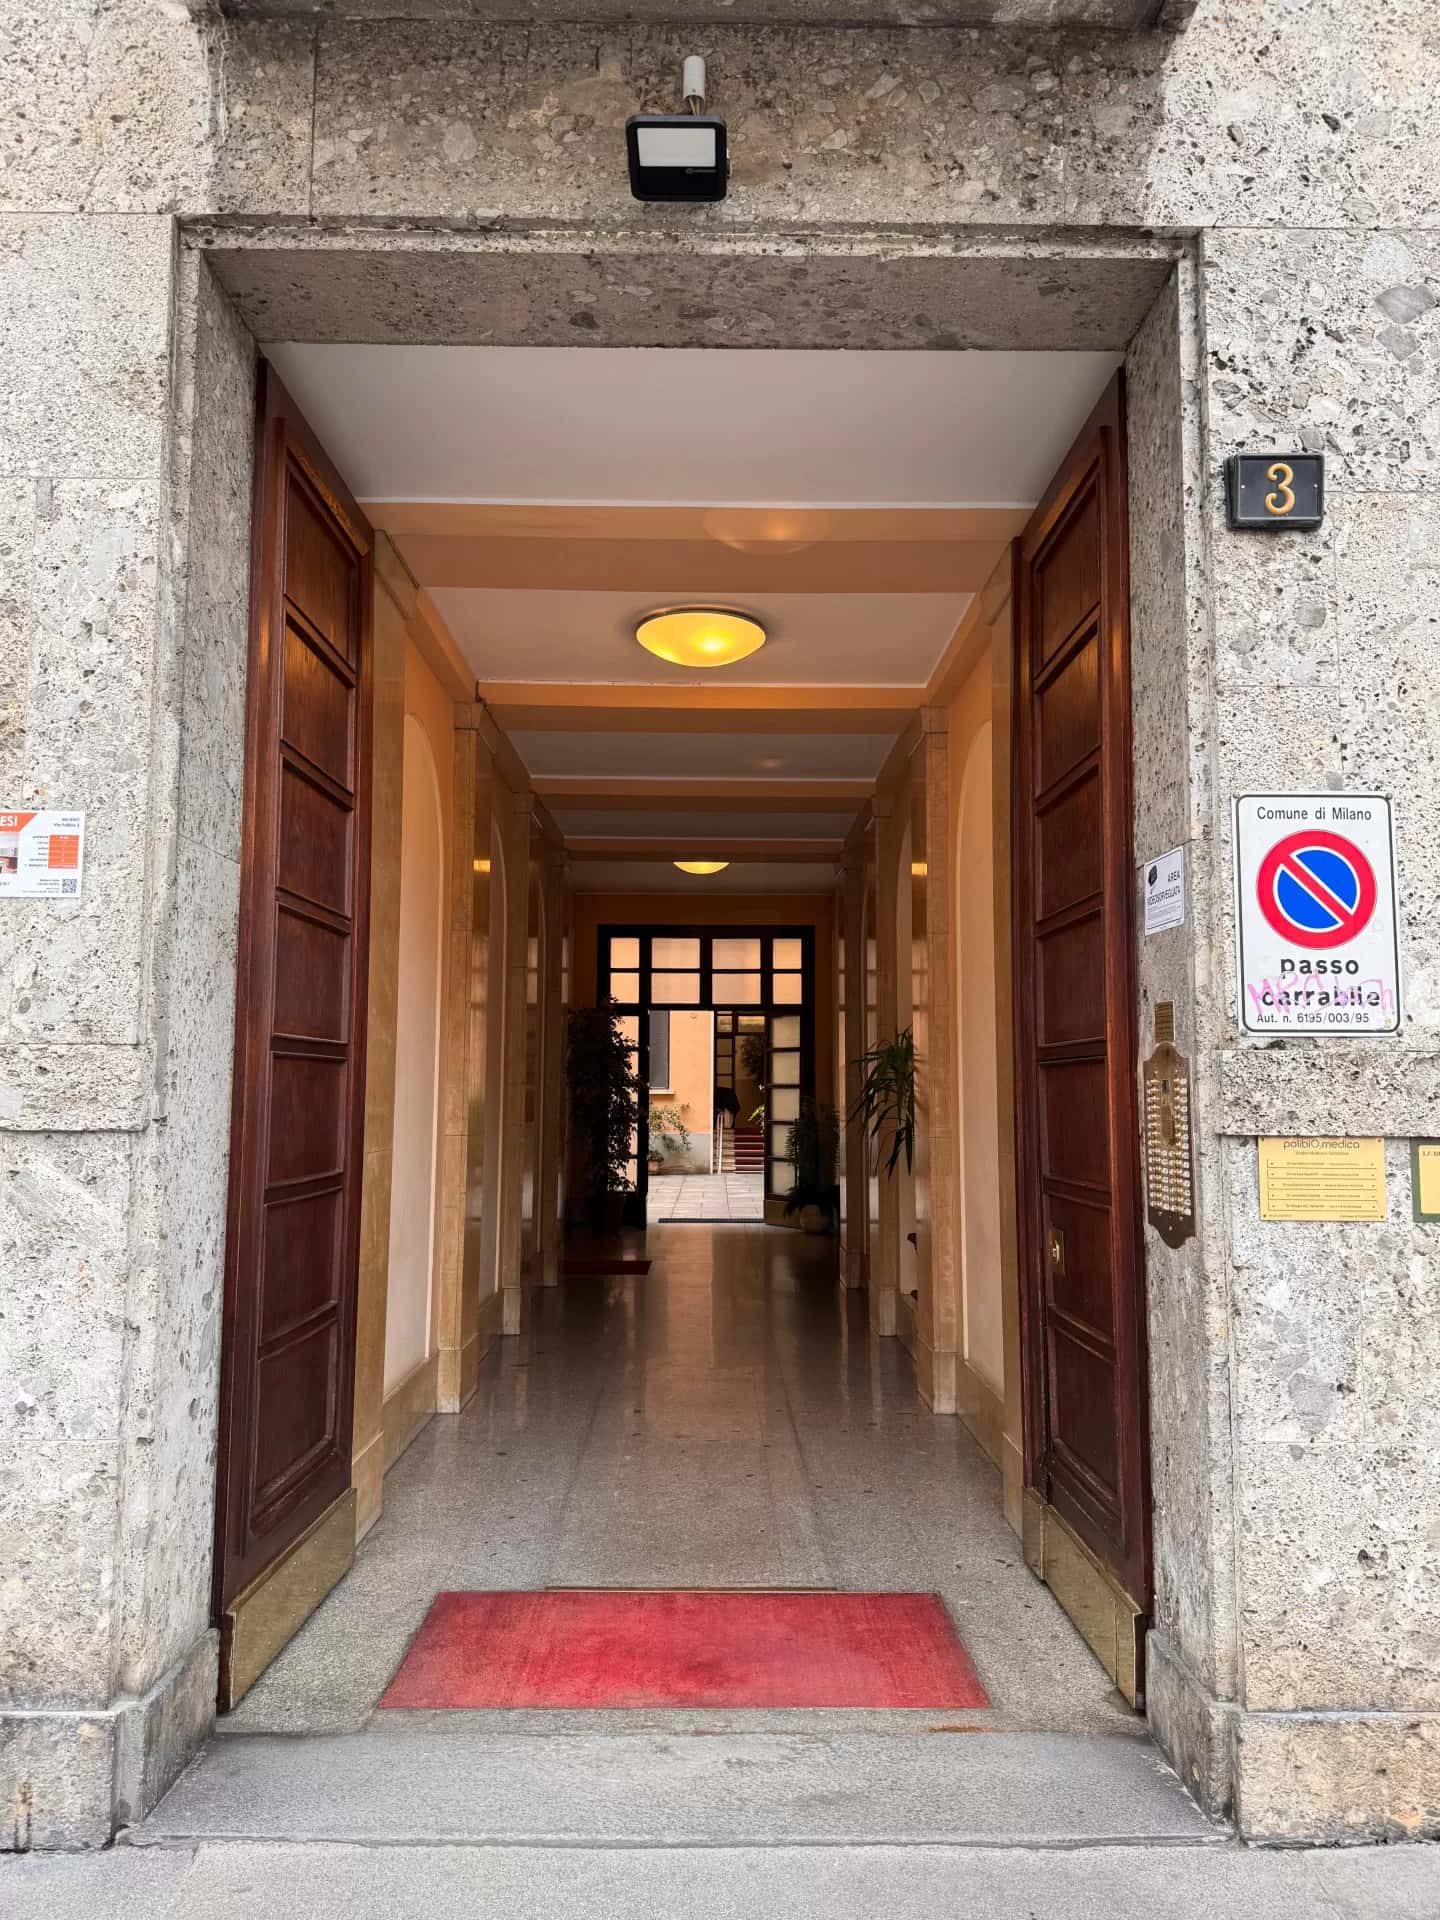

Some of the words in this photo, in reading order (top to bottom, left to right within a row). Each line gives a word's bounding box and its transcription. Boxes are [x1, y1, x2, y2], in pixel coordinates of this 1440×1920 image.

[1265, 463, 1295, 515] 3
[0, 815, 18, 827] ESI
[1257, 806, 1308, 820] Comune
[1314, 807, 1327, 820] di
[1332, 807, 1372, 821] Milano
[1167, 870, 1180, 883] AREA
[1280, 958, 1359, 979] passo
[1262, 985, 1381, 1007] carrabile
[1256, 1013, 1277, 1023] Aut.
[1283, 1015, 1292, 1023] n.
[1297, 1012, 1370, 1024] 6195/003/95
